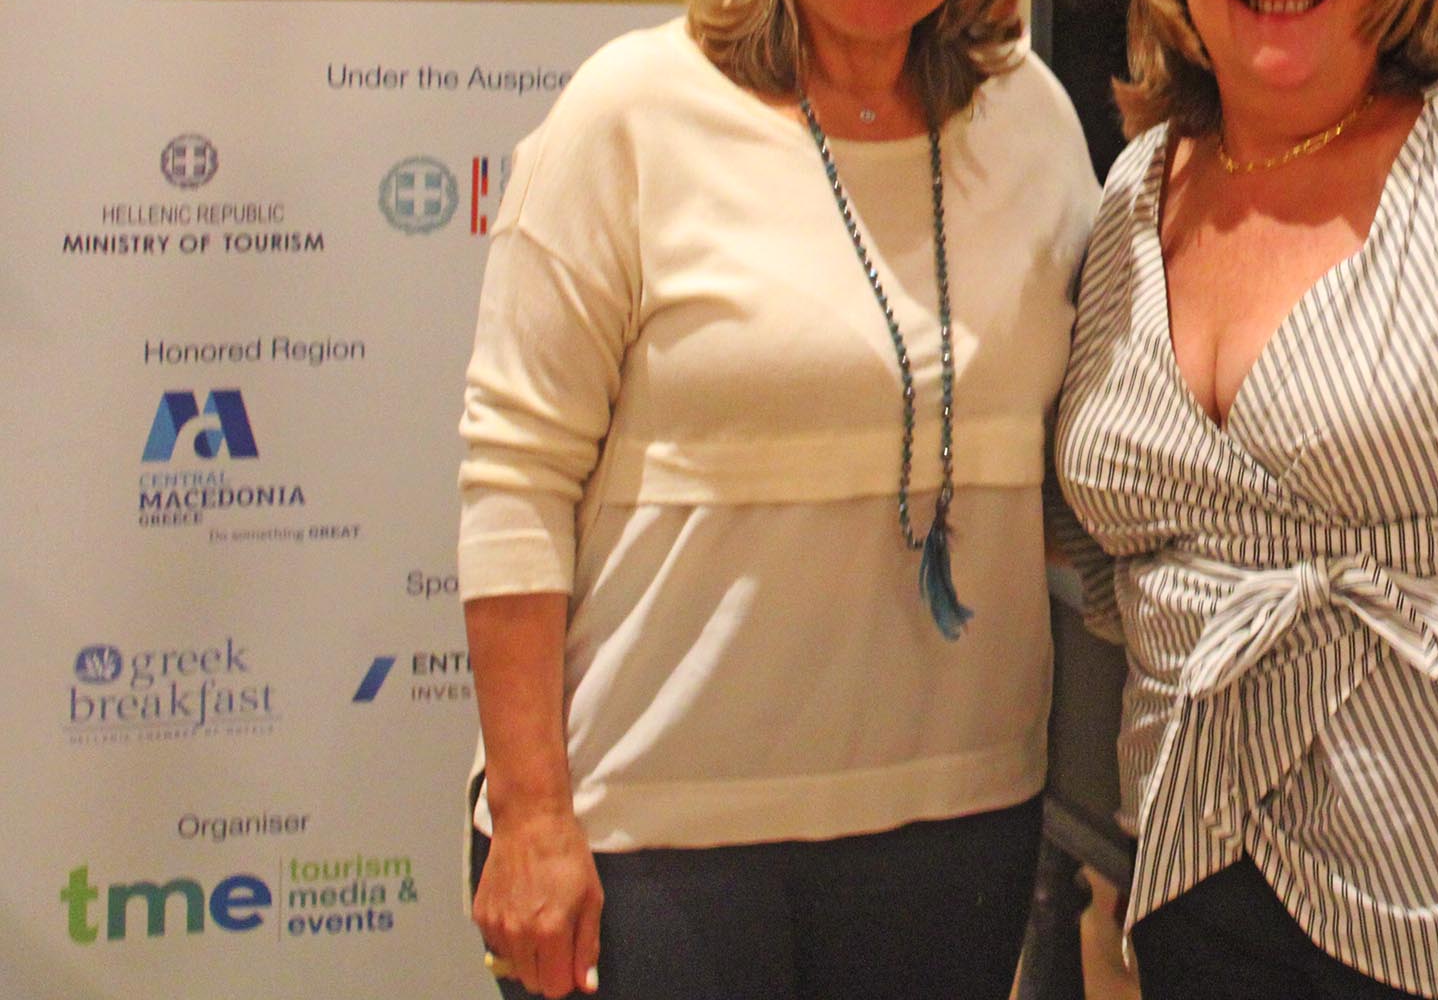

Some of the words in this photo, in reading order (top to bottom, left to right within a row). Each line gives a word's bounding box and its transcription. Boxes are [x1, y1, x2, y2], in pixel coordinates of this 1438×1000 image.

[326, 63, 409, 90] Under
[418, 65, 459, 90] the
[101, 202, 191, 227] HELLENIC
[197, 202, 285, 226] REPUBLIC
[62, 231, 170, 255] MINISTRY
[178, 231, 210, 254] OF
[223, 230, 325, 255] TOURISM
[144, 336, 262, 365] Honored
[271, 334, 366, 368] Region
[139, 471, 226, 490] CENTRAL
[138, 484, 306, 511] MACEDONIA
[308, 523, 361, 541] GREAT
[130, 636, 247, 690] greek
[69, 678, 276, 728] breakfast
[177, 811, 310, 843] Organiser
[289, 853, 413, 883] tourism
[59, 860, 273, 946] tme
[288, 879, 387, 909] media
[397, 877, 419, 904] &
[287, 906, 395, 937] events
